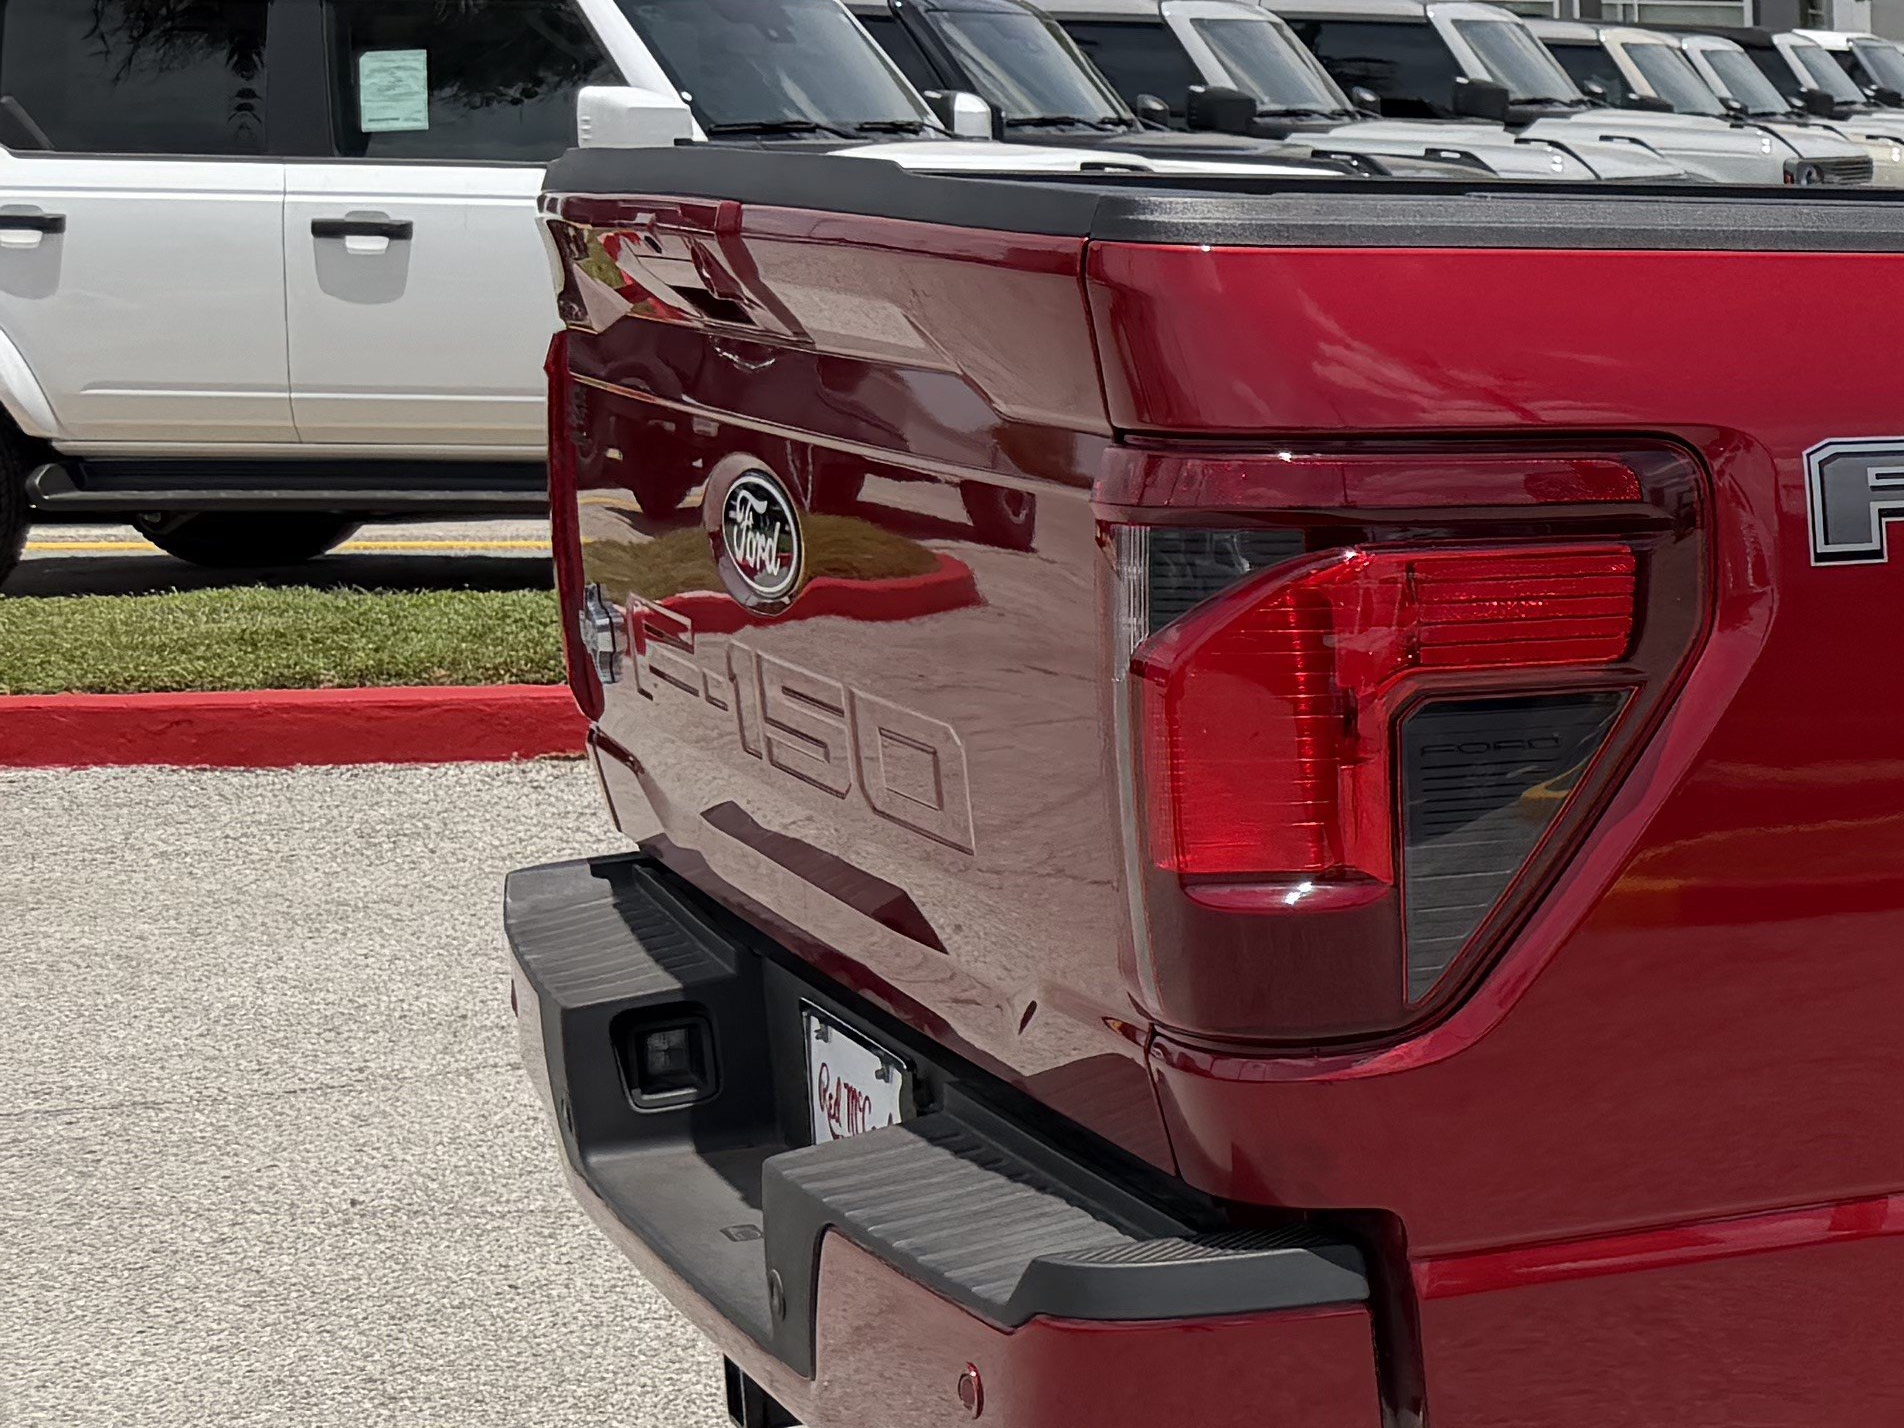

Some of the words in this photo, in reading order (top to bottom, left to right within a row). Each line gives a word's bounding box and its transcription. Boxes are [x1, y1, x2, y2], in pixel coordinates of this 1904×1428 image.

[732, 489, 781, 576] Ford
[625, 589, 977, 858] F-150
[1420, 735, 1560, 756] FORD
